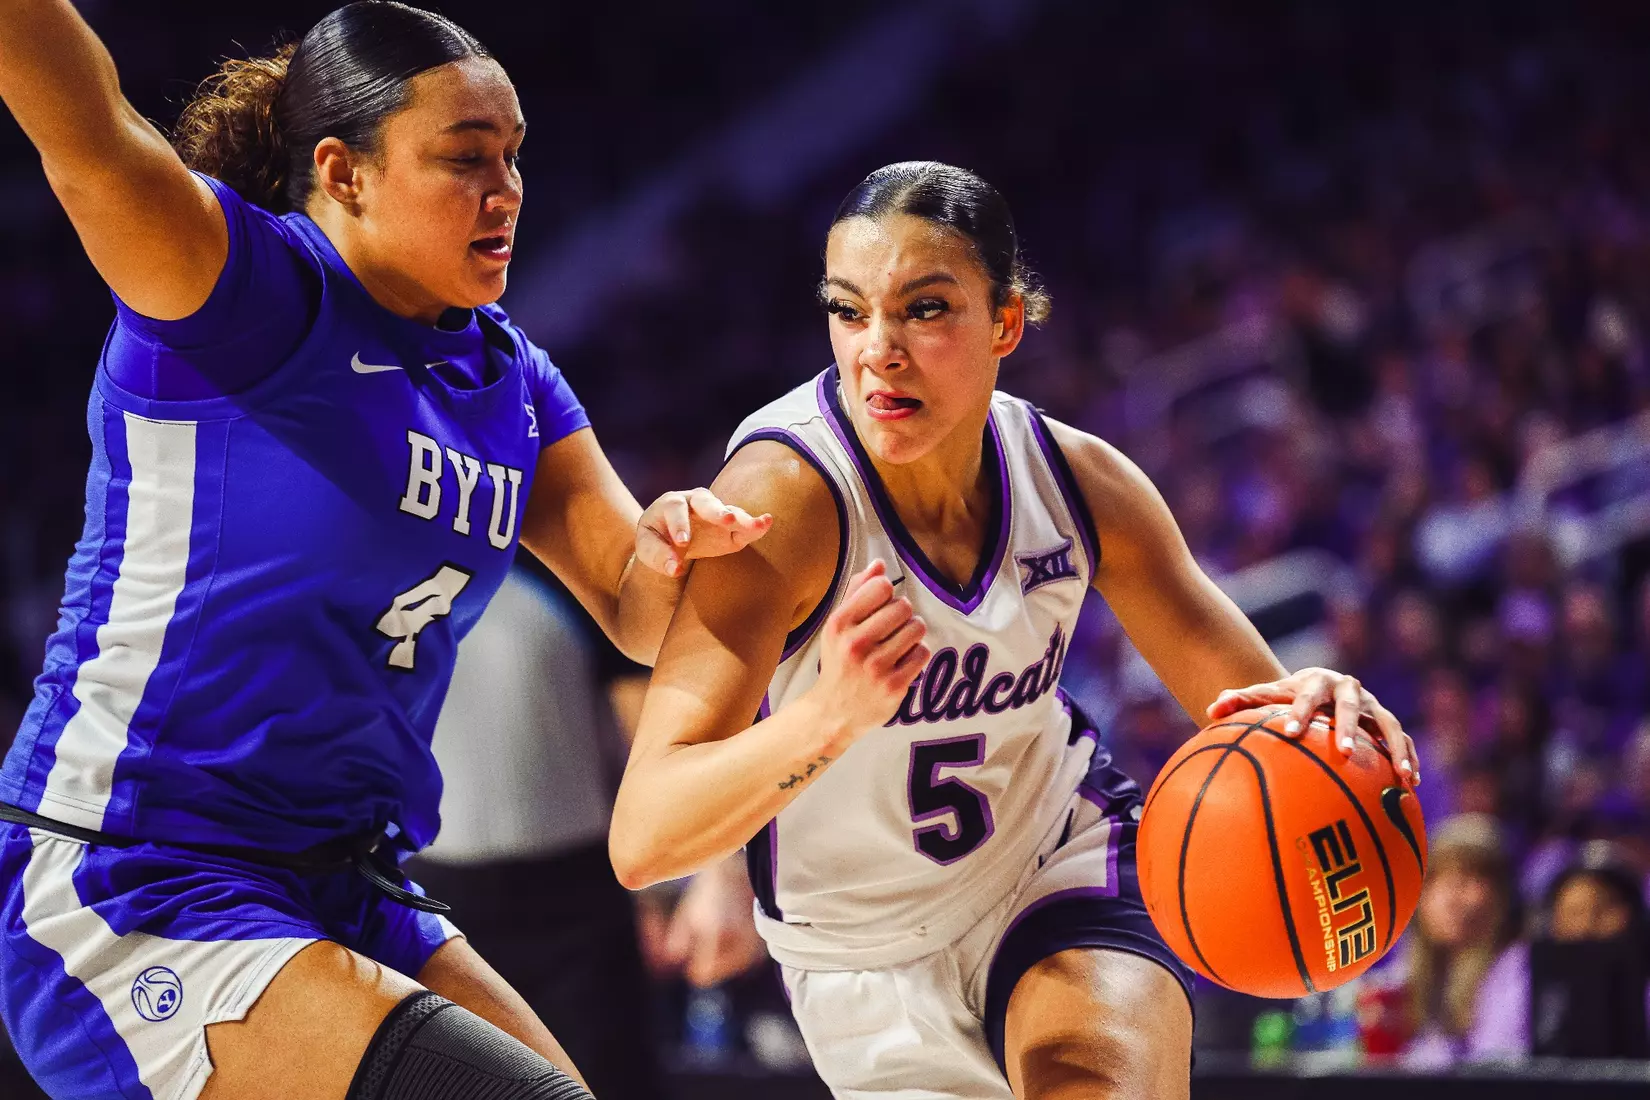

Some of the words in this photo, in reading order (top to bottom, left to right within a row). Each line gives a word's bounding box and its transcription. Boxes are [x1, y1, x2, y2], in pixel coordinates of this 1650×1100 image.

[399, 428, 523, 551] BYU
[371, 561, 476, 672] 4
[883, 621, 1066, 728] ildcat
[906, 732, 995, 867] 5
